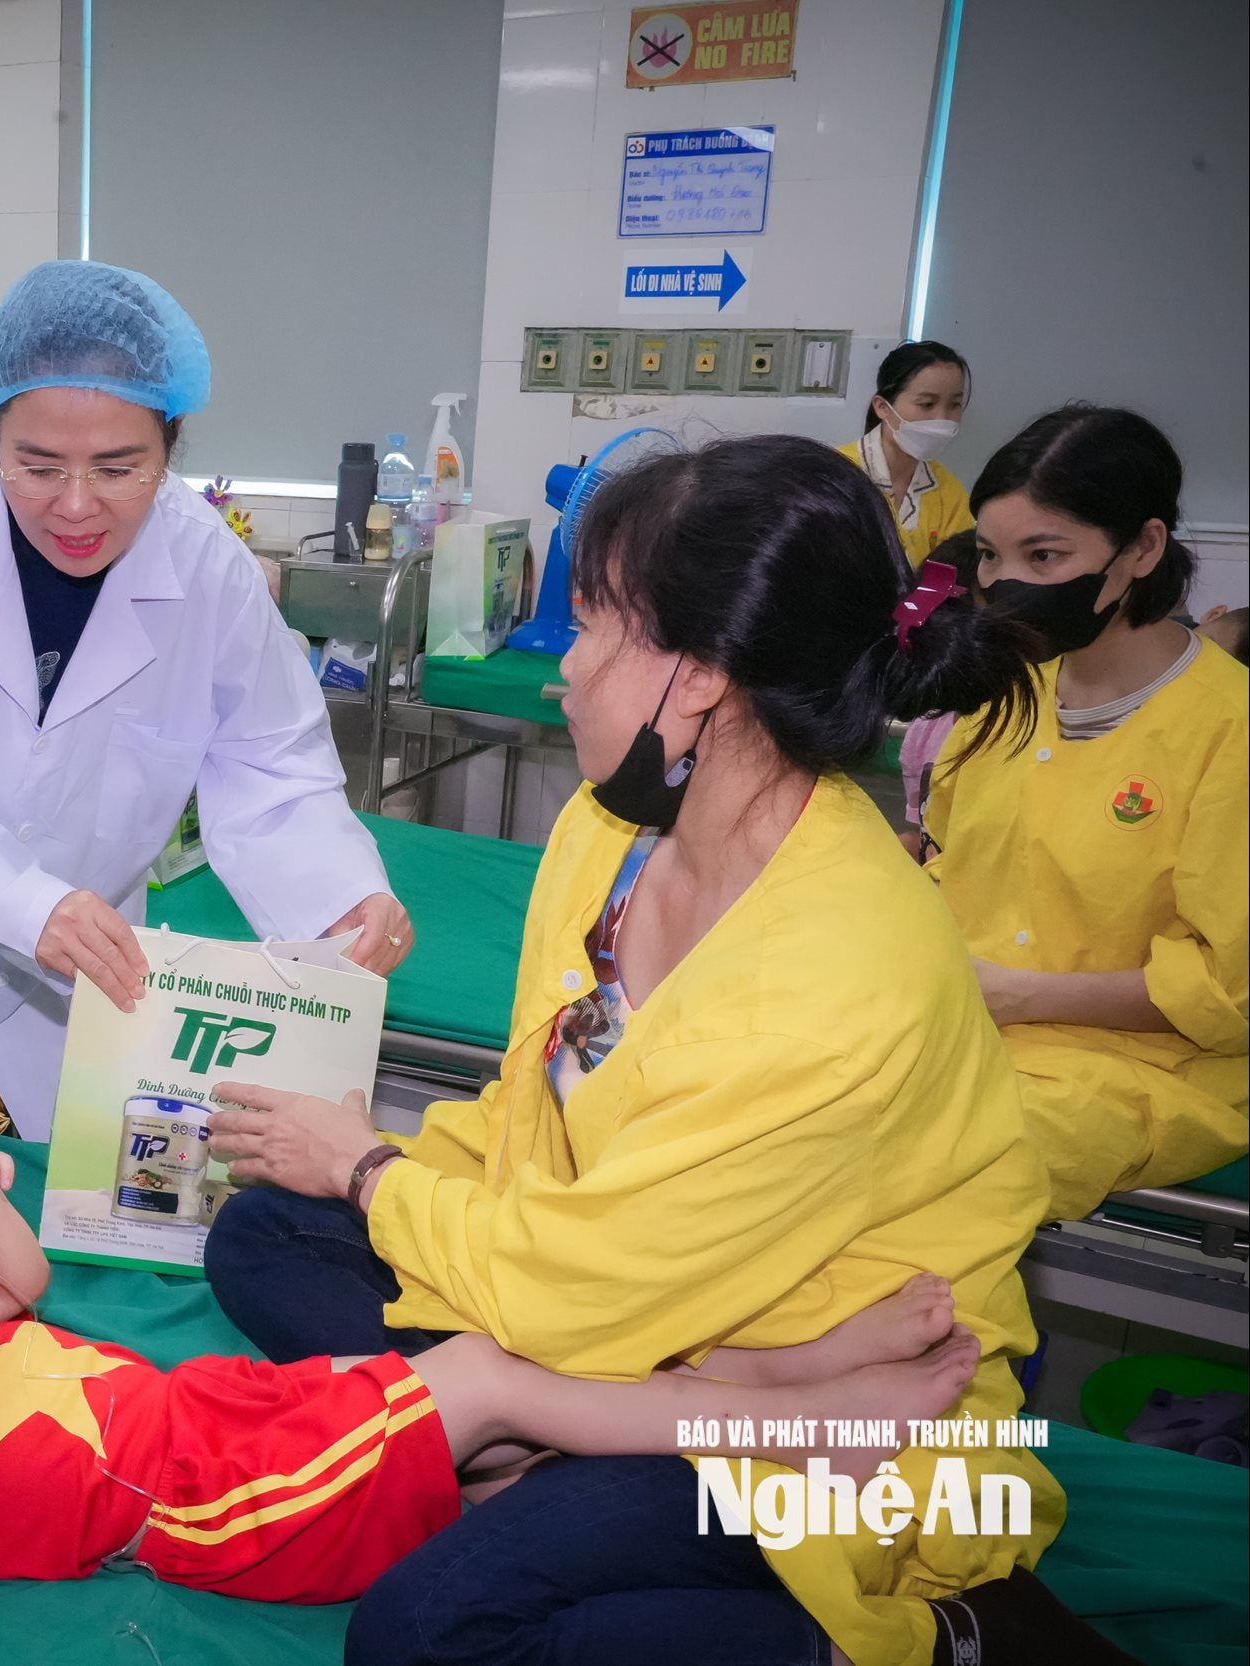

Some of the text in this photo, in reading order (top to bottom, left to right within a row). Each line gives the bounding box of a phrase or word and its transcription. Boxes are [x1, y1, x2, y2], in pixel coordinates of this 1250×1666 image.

[694, 39, 790, 70] NO FIRE
[648, 139, 667, 155] PHỤ
[671, 135, 701, 151] TRÁCH
[631, 268, 647, 292] LỐI
[660, 269, 681, 292] NHÀ
[684, 270, 696, 295] VỆ
[697, 273, 723, 292] SINH
[158, 968, 177, 991] CỔ
[178, 974, 212, 998] PHẦN
[215, 982, 252, 1005] CHUỖI
[256, 990, 287, 1013] THỰC
[289, 994, 327, 1019] PHẨM
[330, 1004, 352, 1024] TTP
[170, 1006, 277, 1075] TTP
[136, 1078, 165, 1094] Dinh
[167, 1083, 206, 1105] Dưỡng
[130, 1132, 170, 1161] TTP
[193, 1256, 205, 1266] HO
